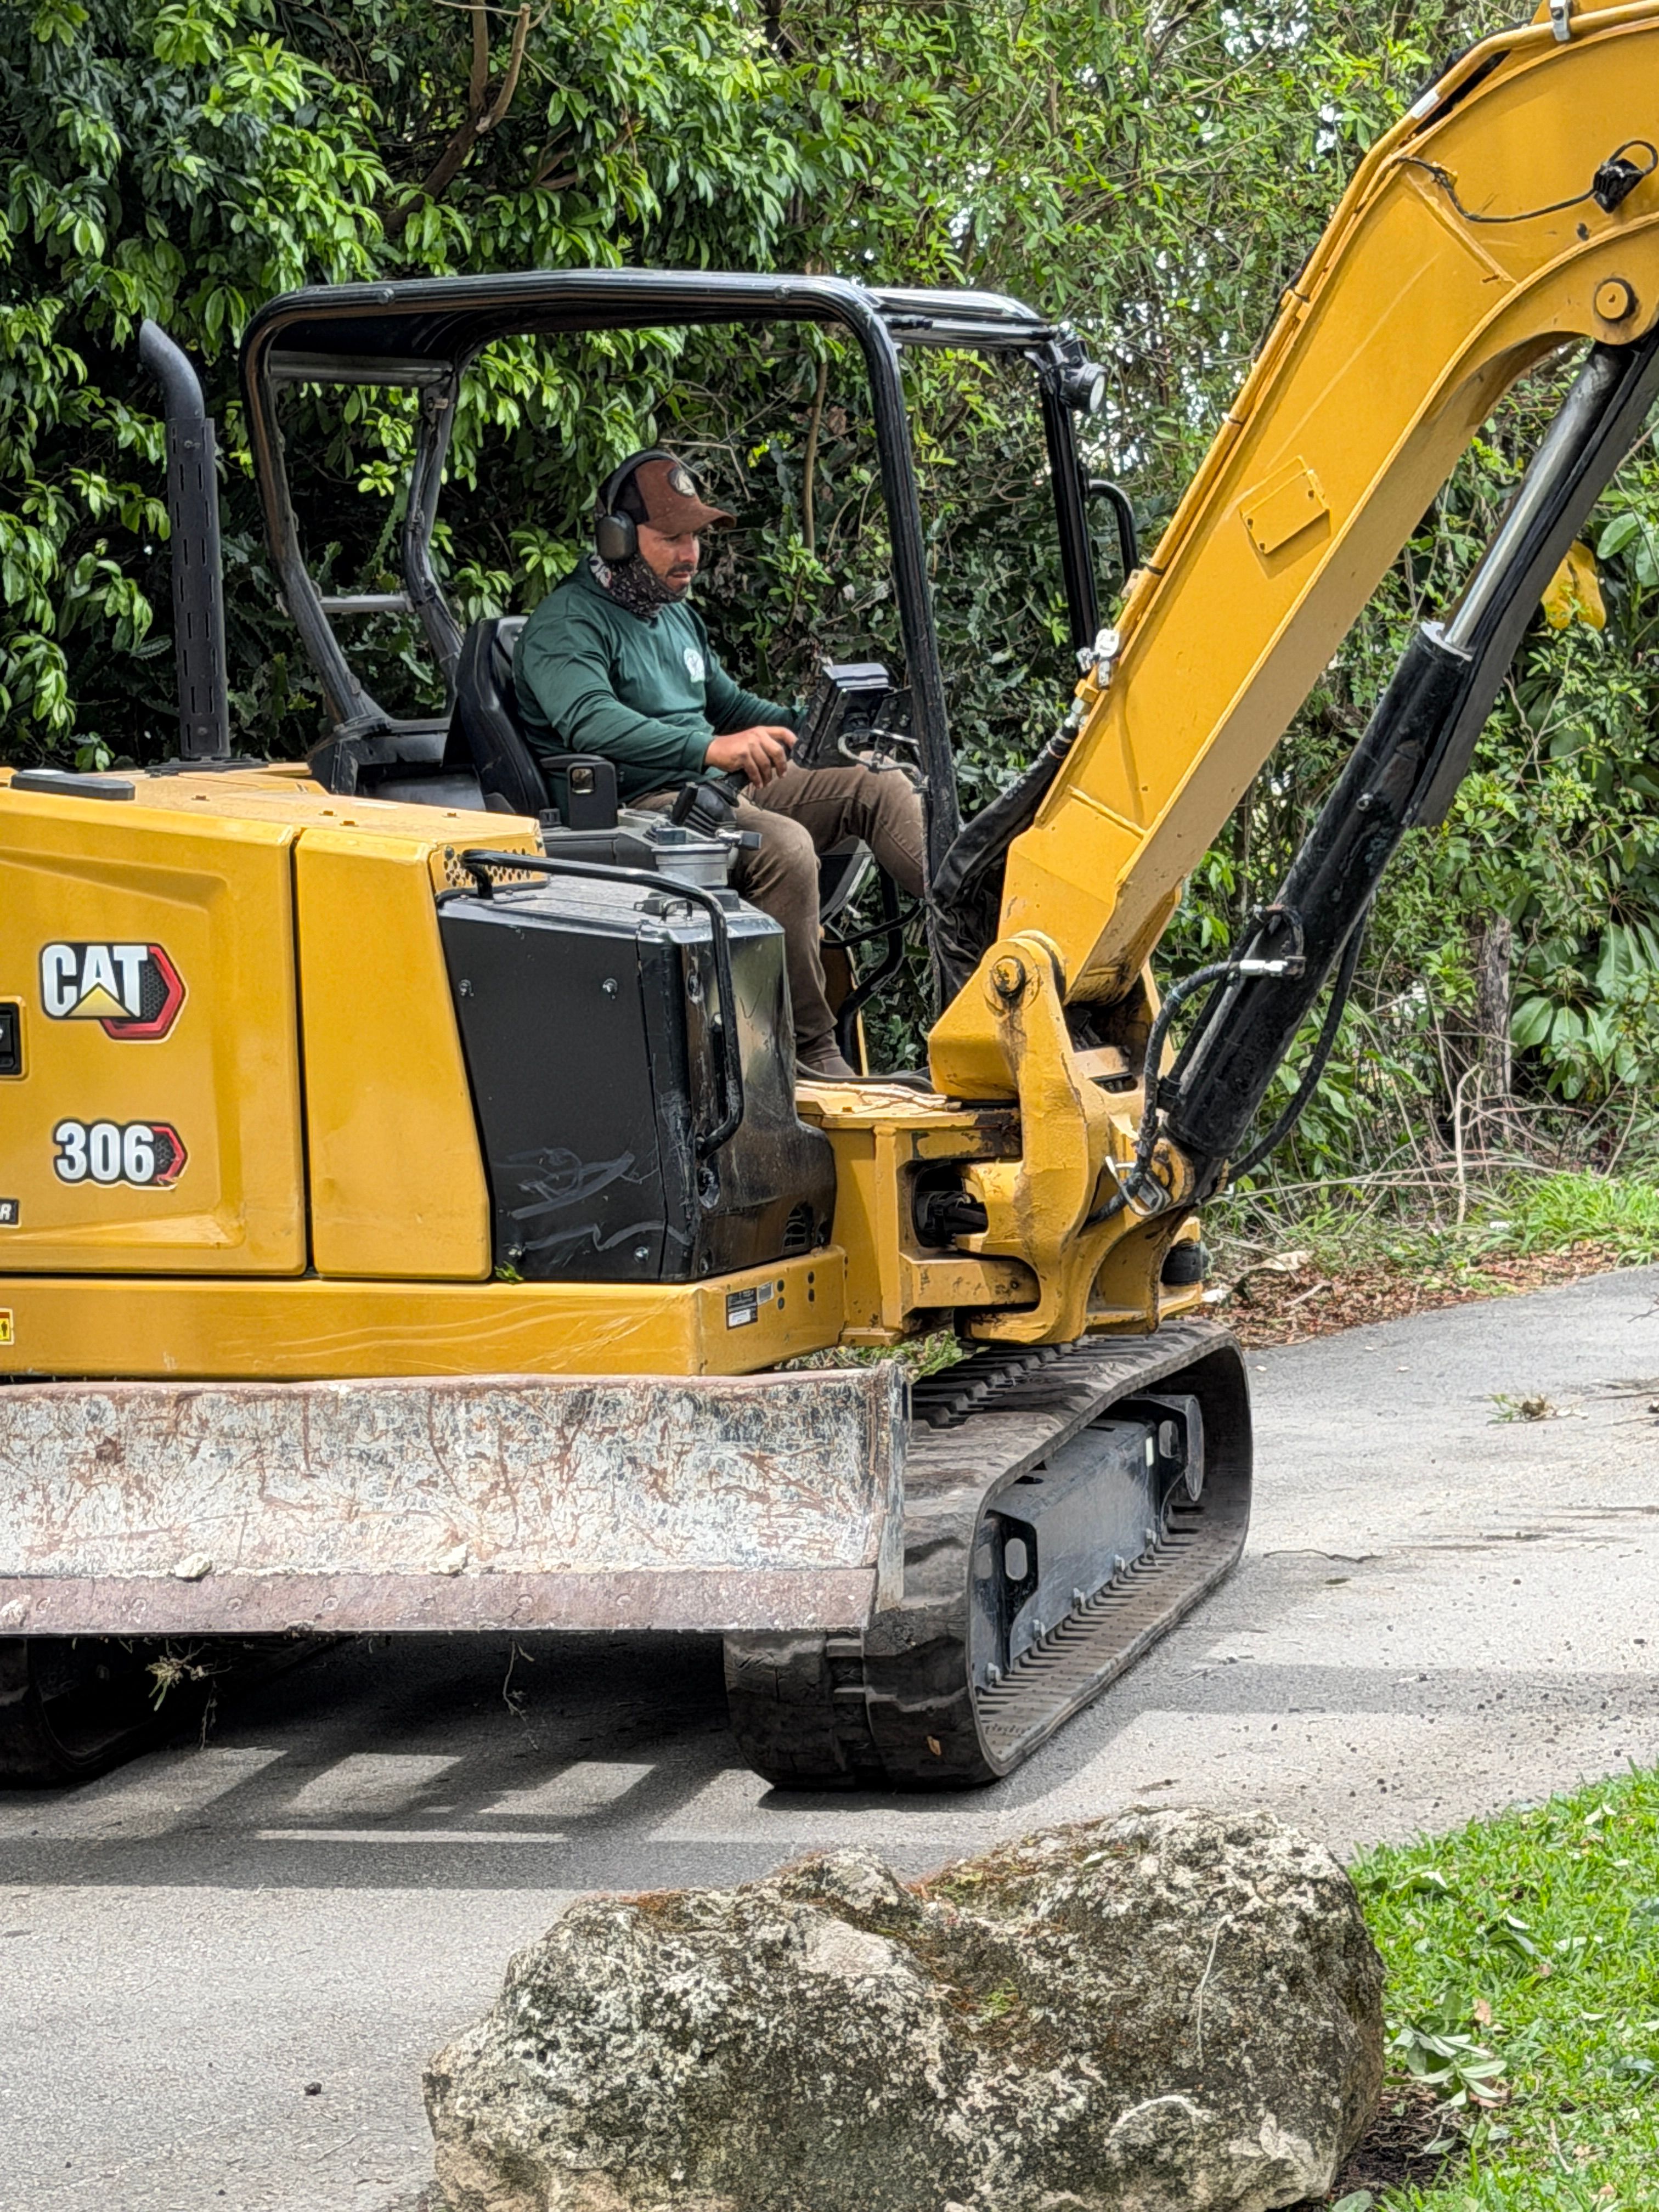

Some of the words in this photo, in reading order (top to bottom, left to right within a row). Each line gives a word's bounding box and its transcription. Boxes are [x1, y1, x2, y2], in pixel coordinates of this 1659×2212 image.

[42, 944, 147, 1017] CAT
[56, 1122, 154, 1182] 306
[0, 1203, 12, 1220] R
